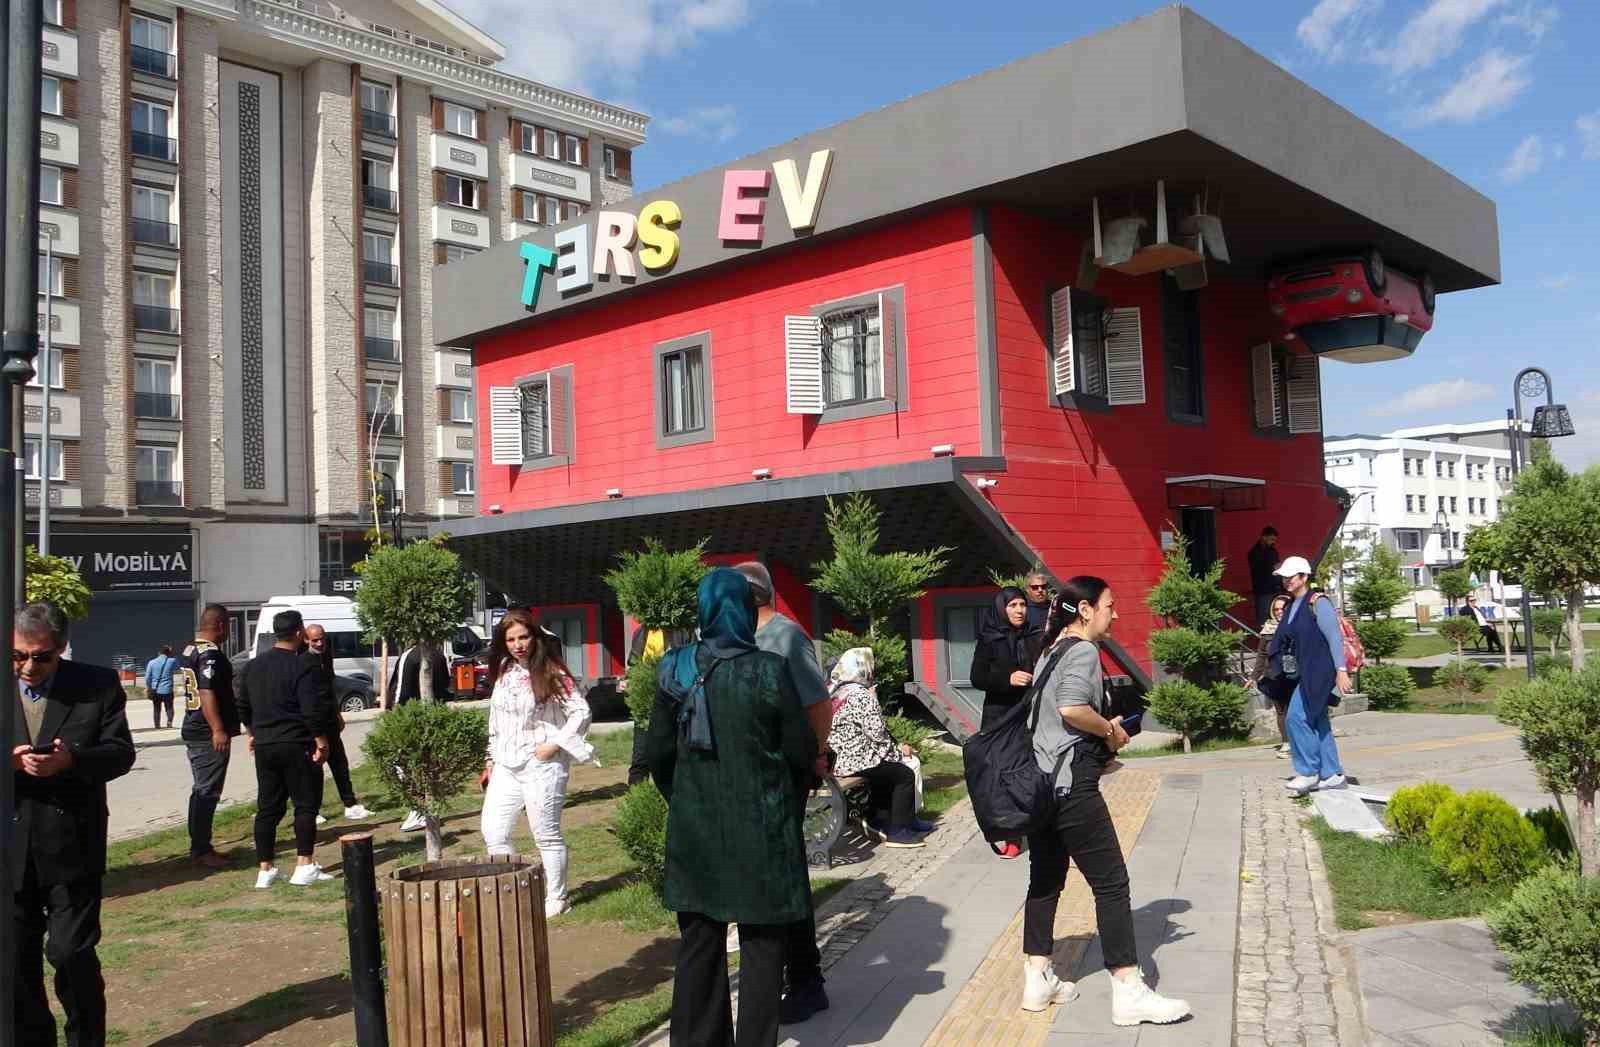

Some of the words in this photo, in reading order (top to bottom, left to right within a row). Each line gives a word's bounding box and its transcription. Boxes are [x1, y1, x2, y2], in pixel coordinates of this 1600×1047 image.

[520, 199, 682, 309] TERS
[718, 148, 835, 241] EV
[94, 551, 187, 573] MOBİLYA
